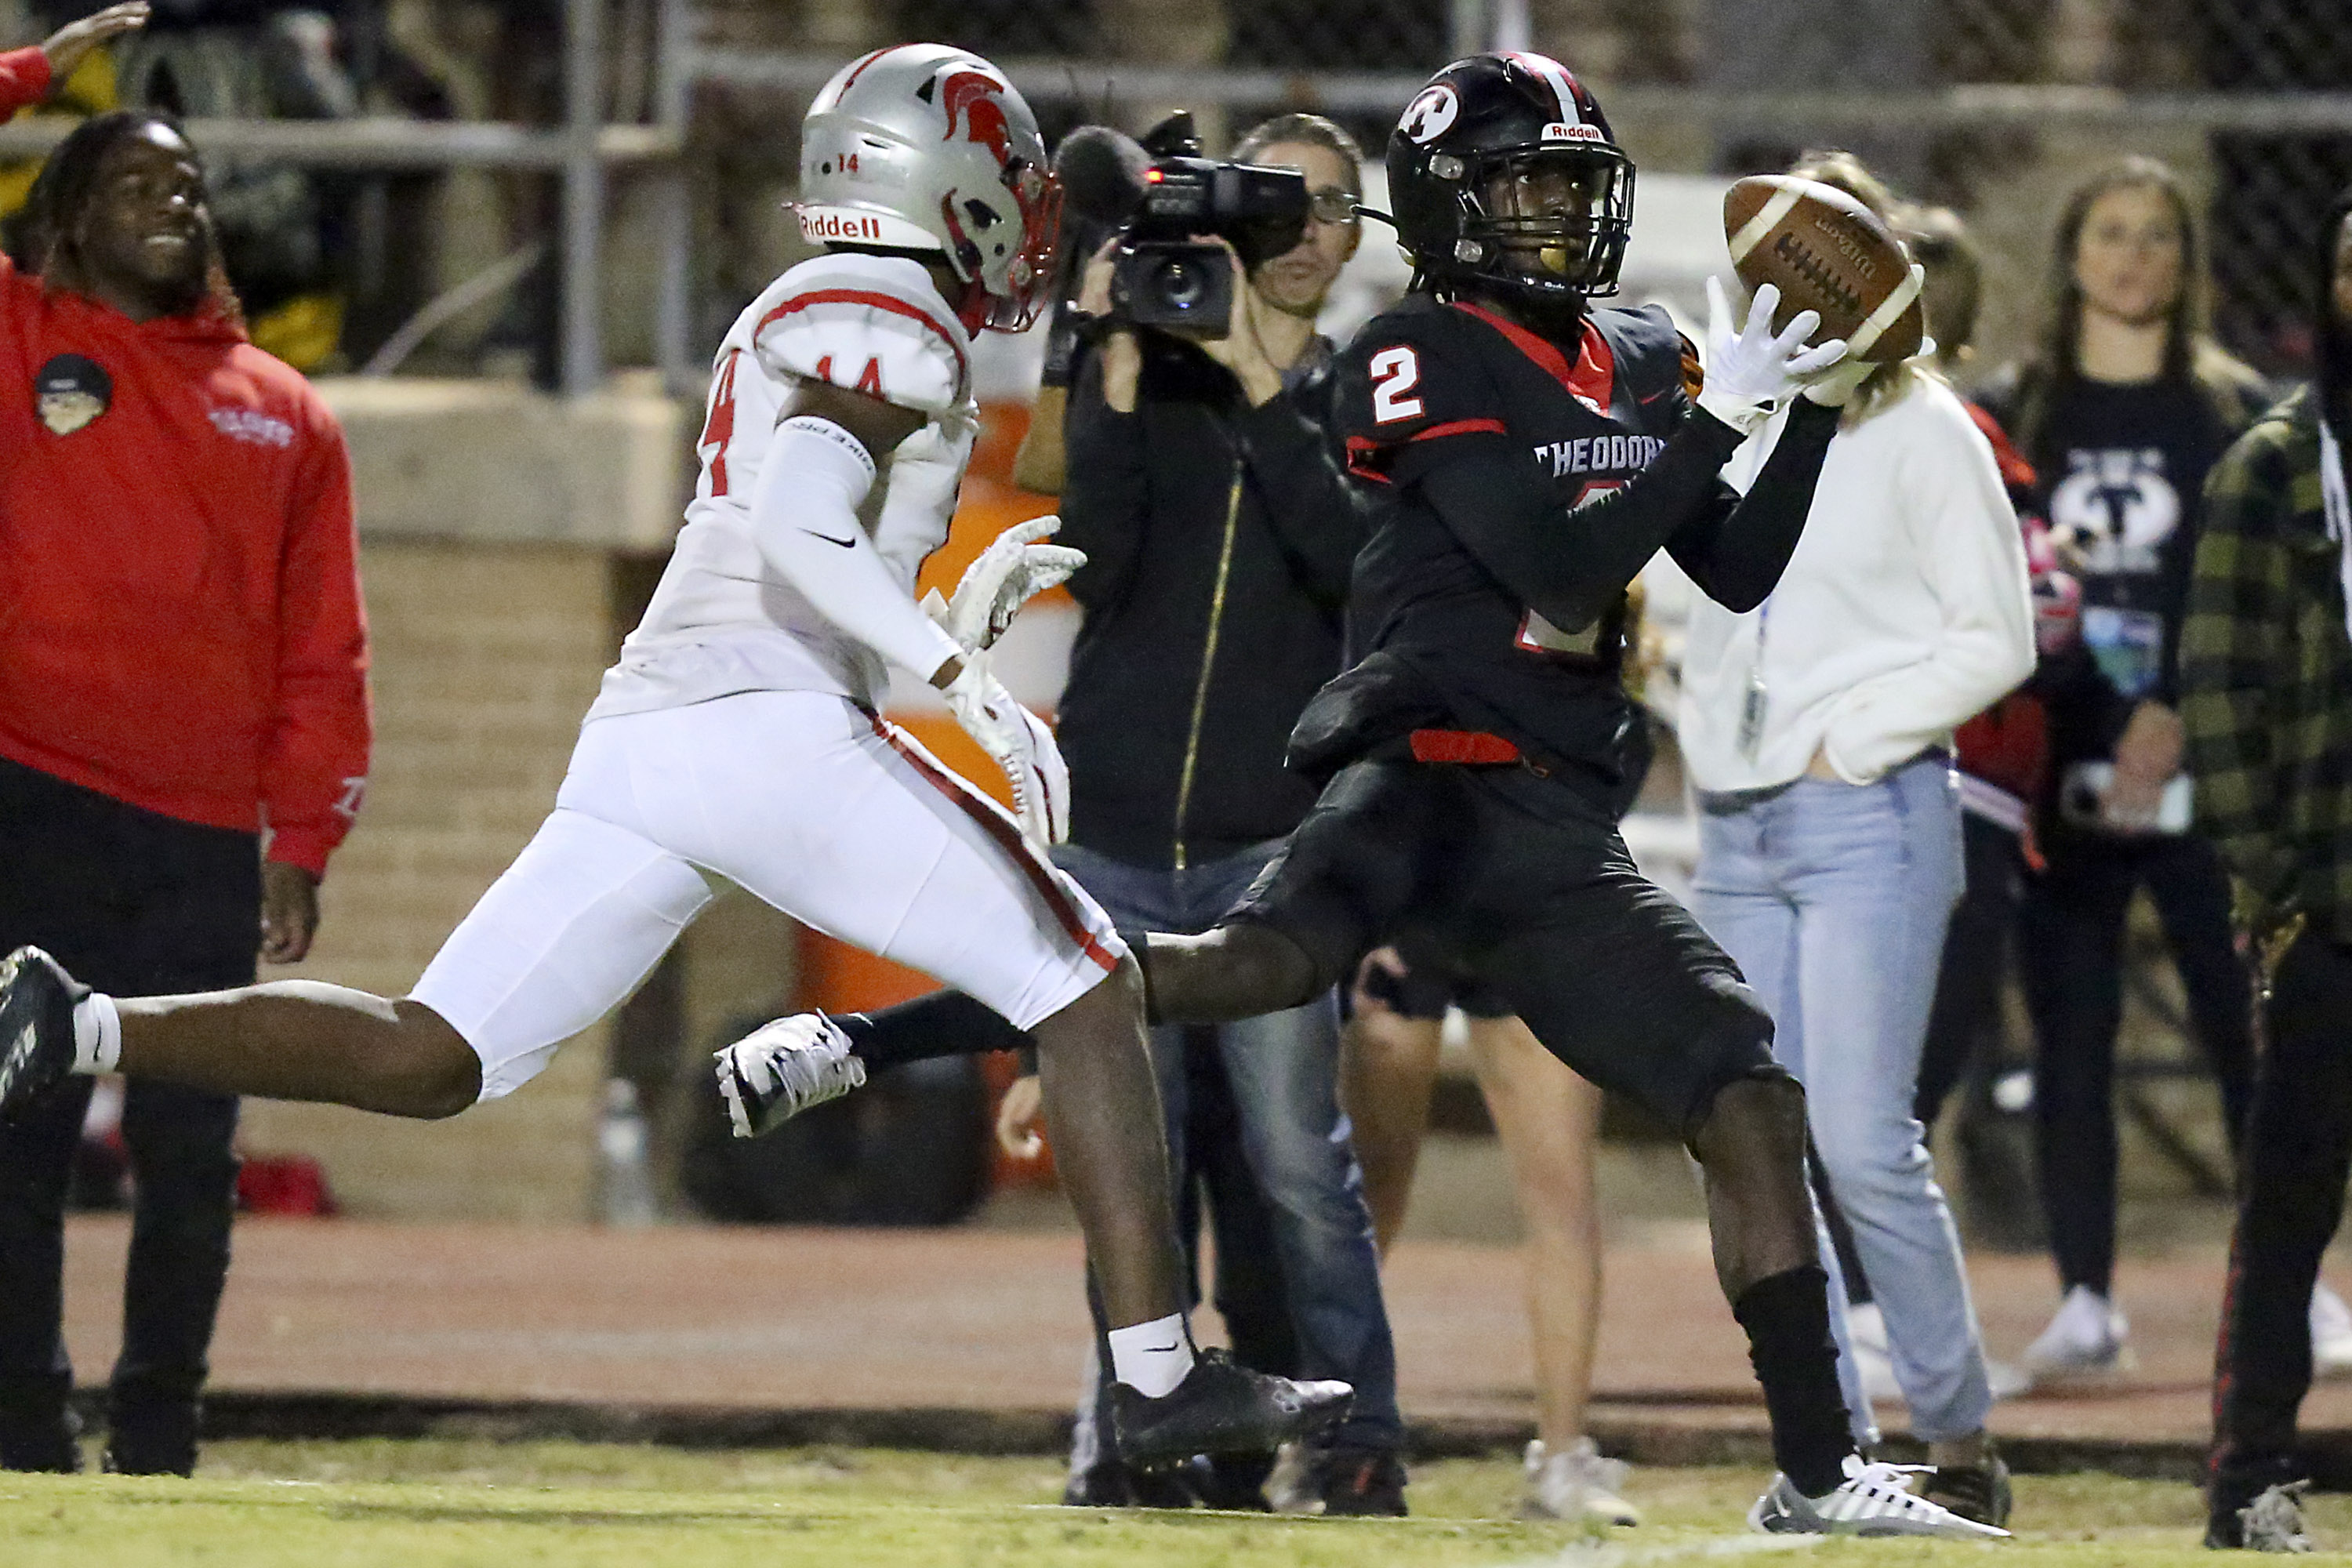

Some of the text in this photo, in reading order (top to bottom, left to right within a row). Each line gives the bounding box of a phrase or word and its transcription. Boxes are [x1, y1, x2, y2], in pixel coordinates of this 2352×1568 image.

[1552, 125, 1599, 139] Riddell
[837, 153, 858, 173] 14
[800, 214, 880, 238] Riddell
[1368, 344, 1425, 426] 2
